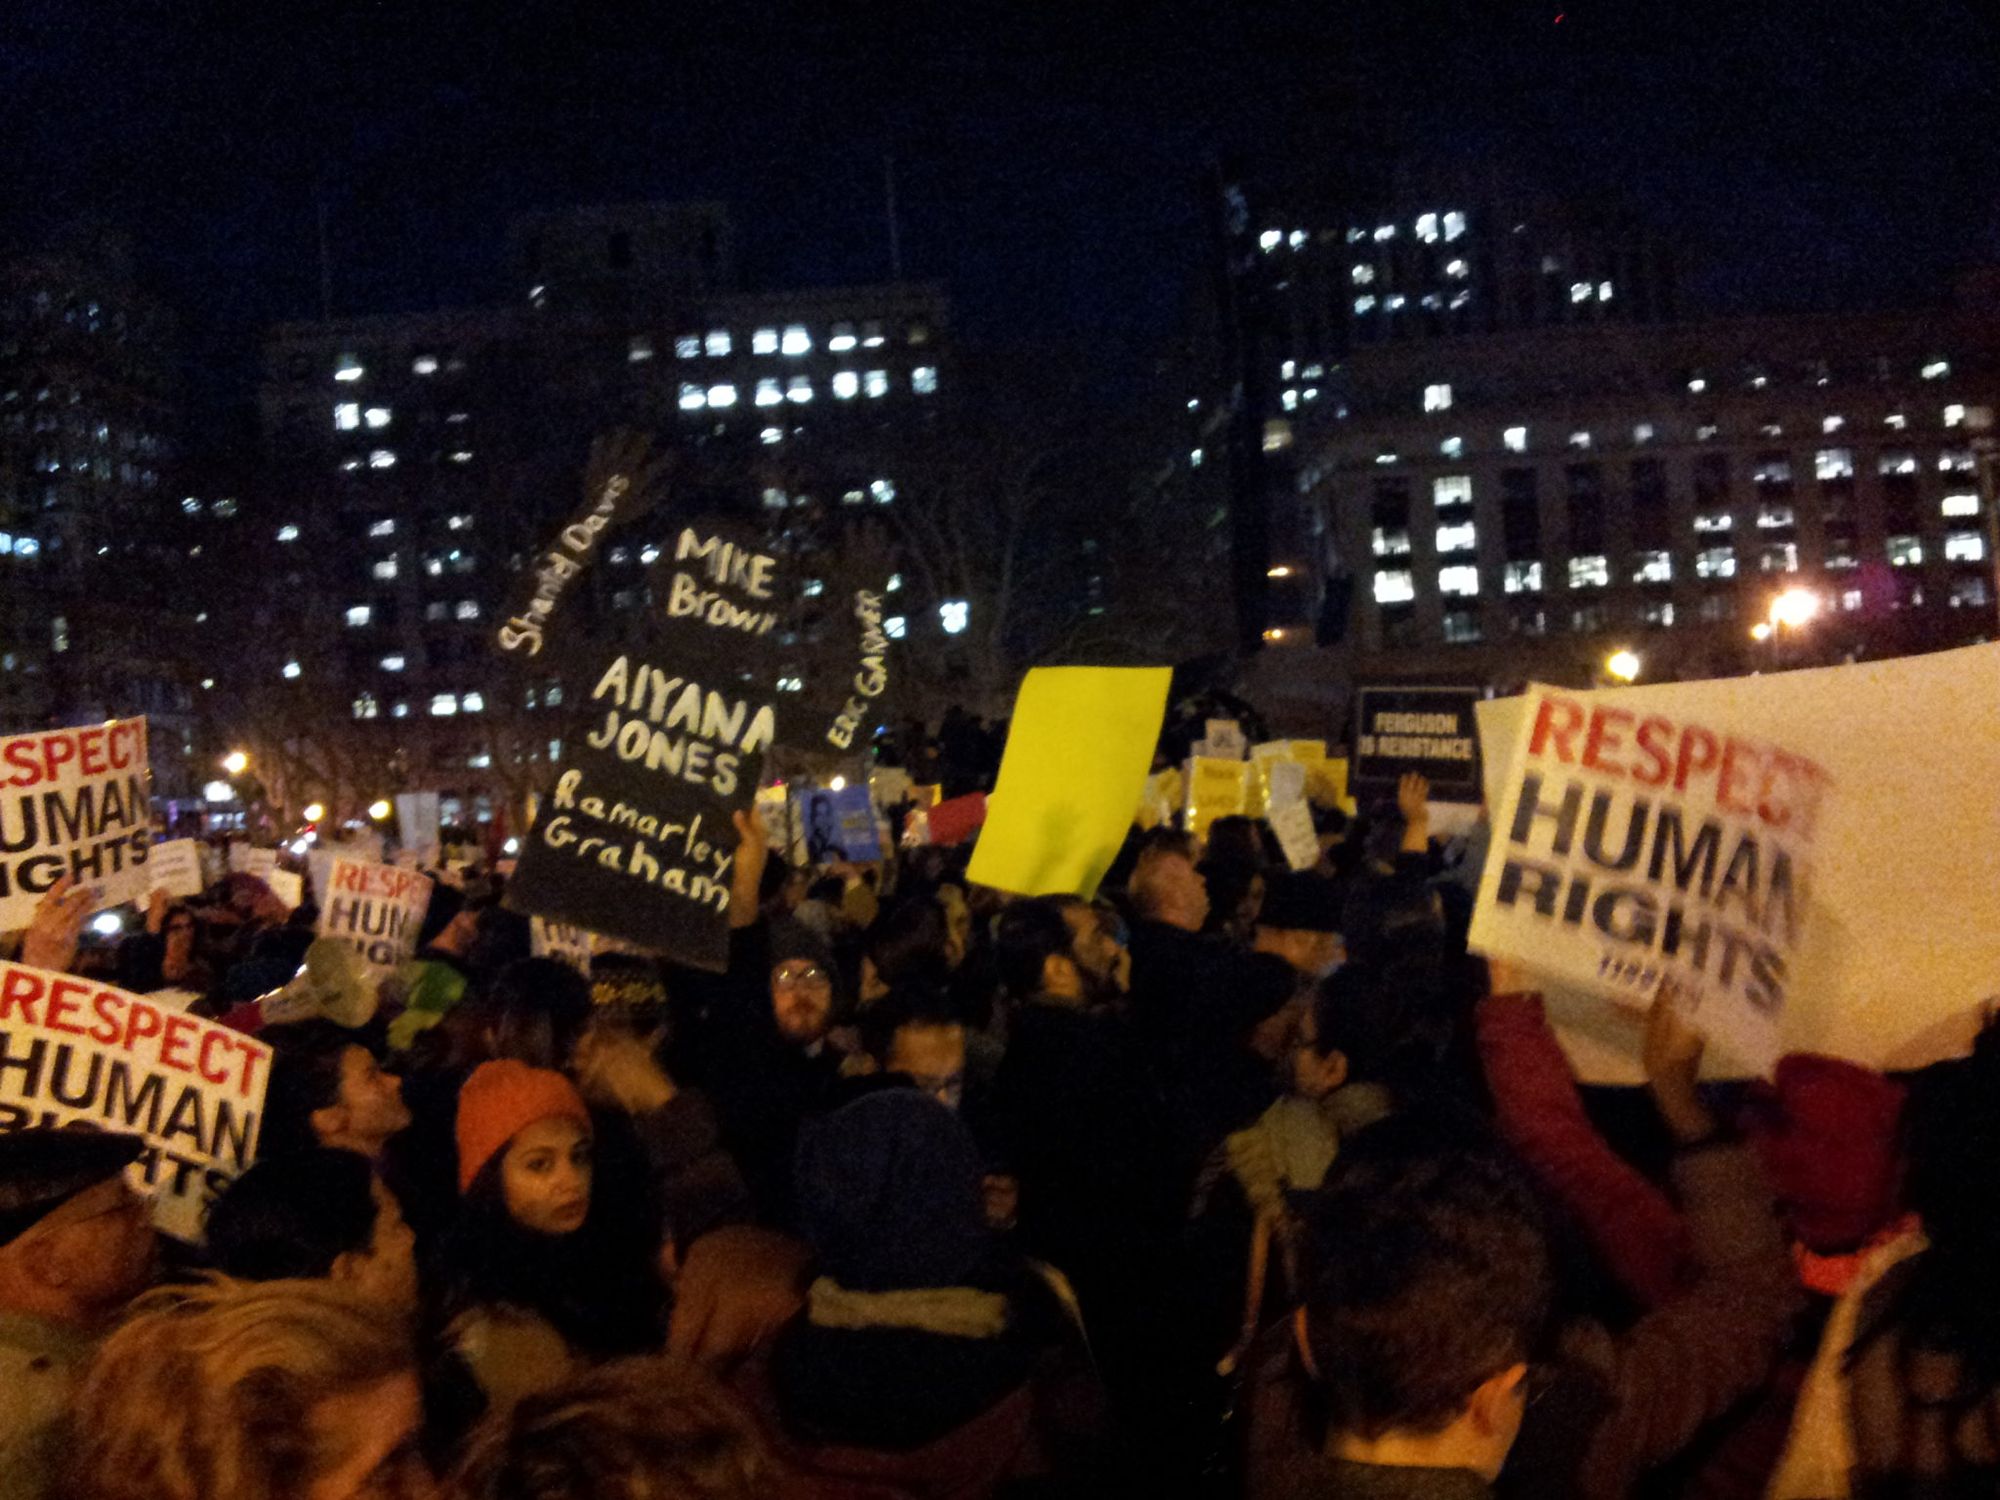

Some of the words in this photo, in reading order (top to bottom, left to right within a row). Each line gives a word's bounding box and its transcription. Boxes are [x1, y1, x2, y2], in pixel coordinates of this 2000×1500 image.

[666, 572, 778, 637] Brown
[675, 527, 776, 598] MIKE
[586, 711, 740, 795] JONES
[591, 655, 774, 755] AIYANA
[0, 721, 145, 790] SPECT
[544, 816, 731, 913] Graham
[553, 769, 732, 882] Ramarley
[1509, 771, 1801, 945] HUMAN
[1497, 858, 1788, 1018] RIGHTS
[0, 968, 264, 1098] RESPECT
[0, 1032, 256, 1170] HUMAN
